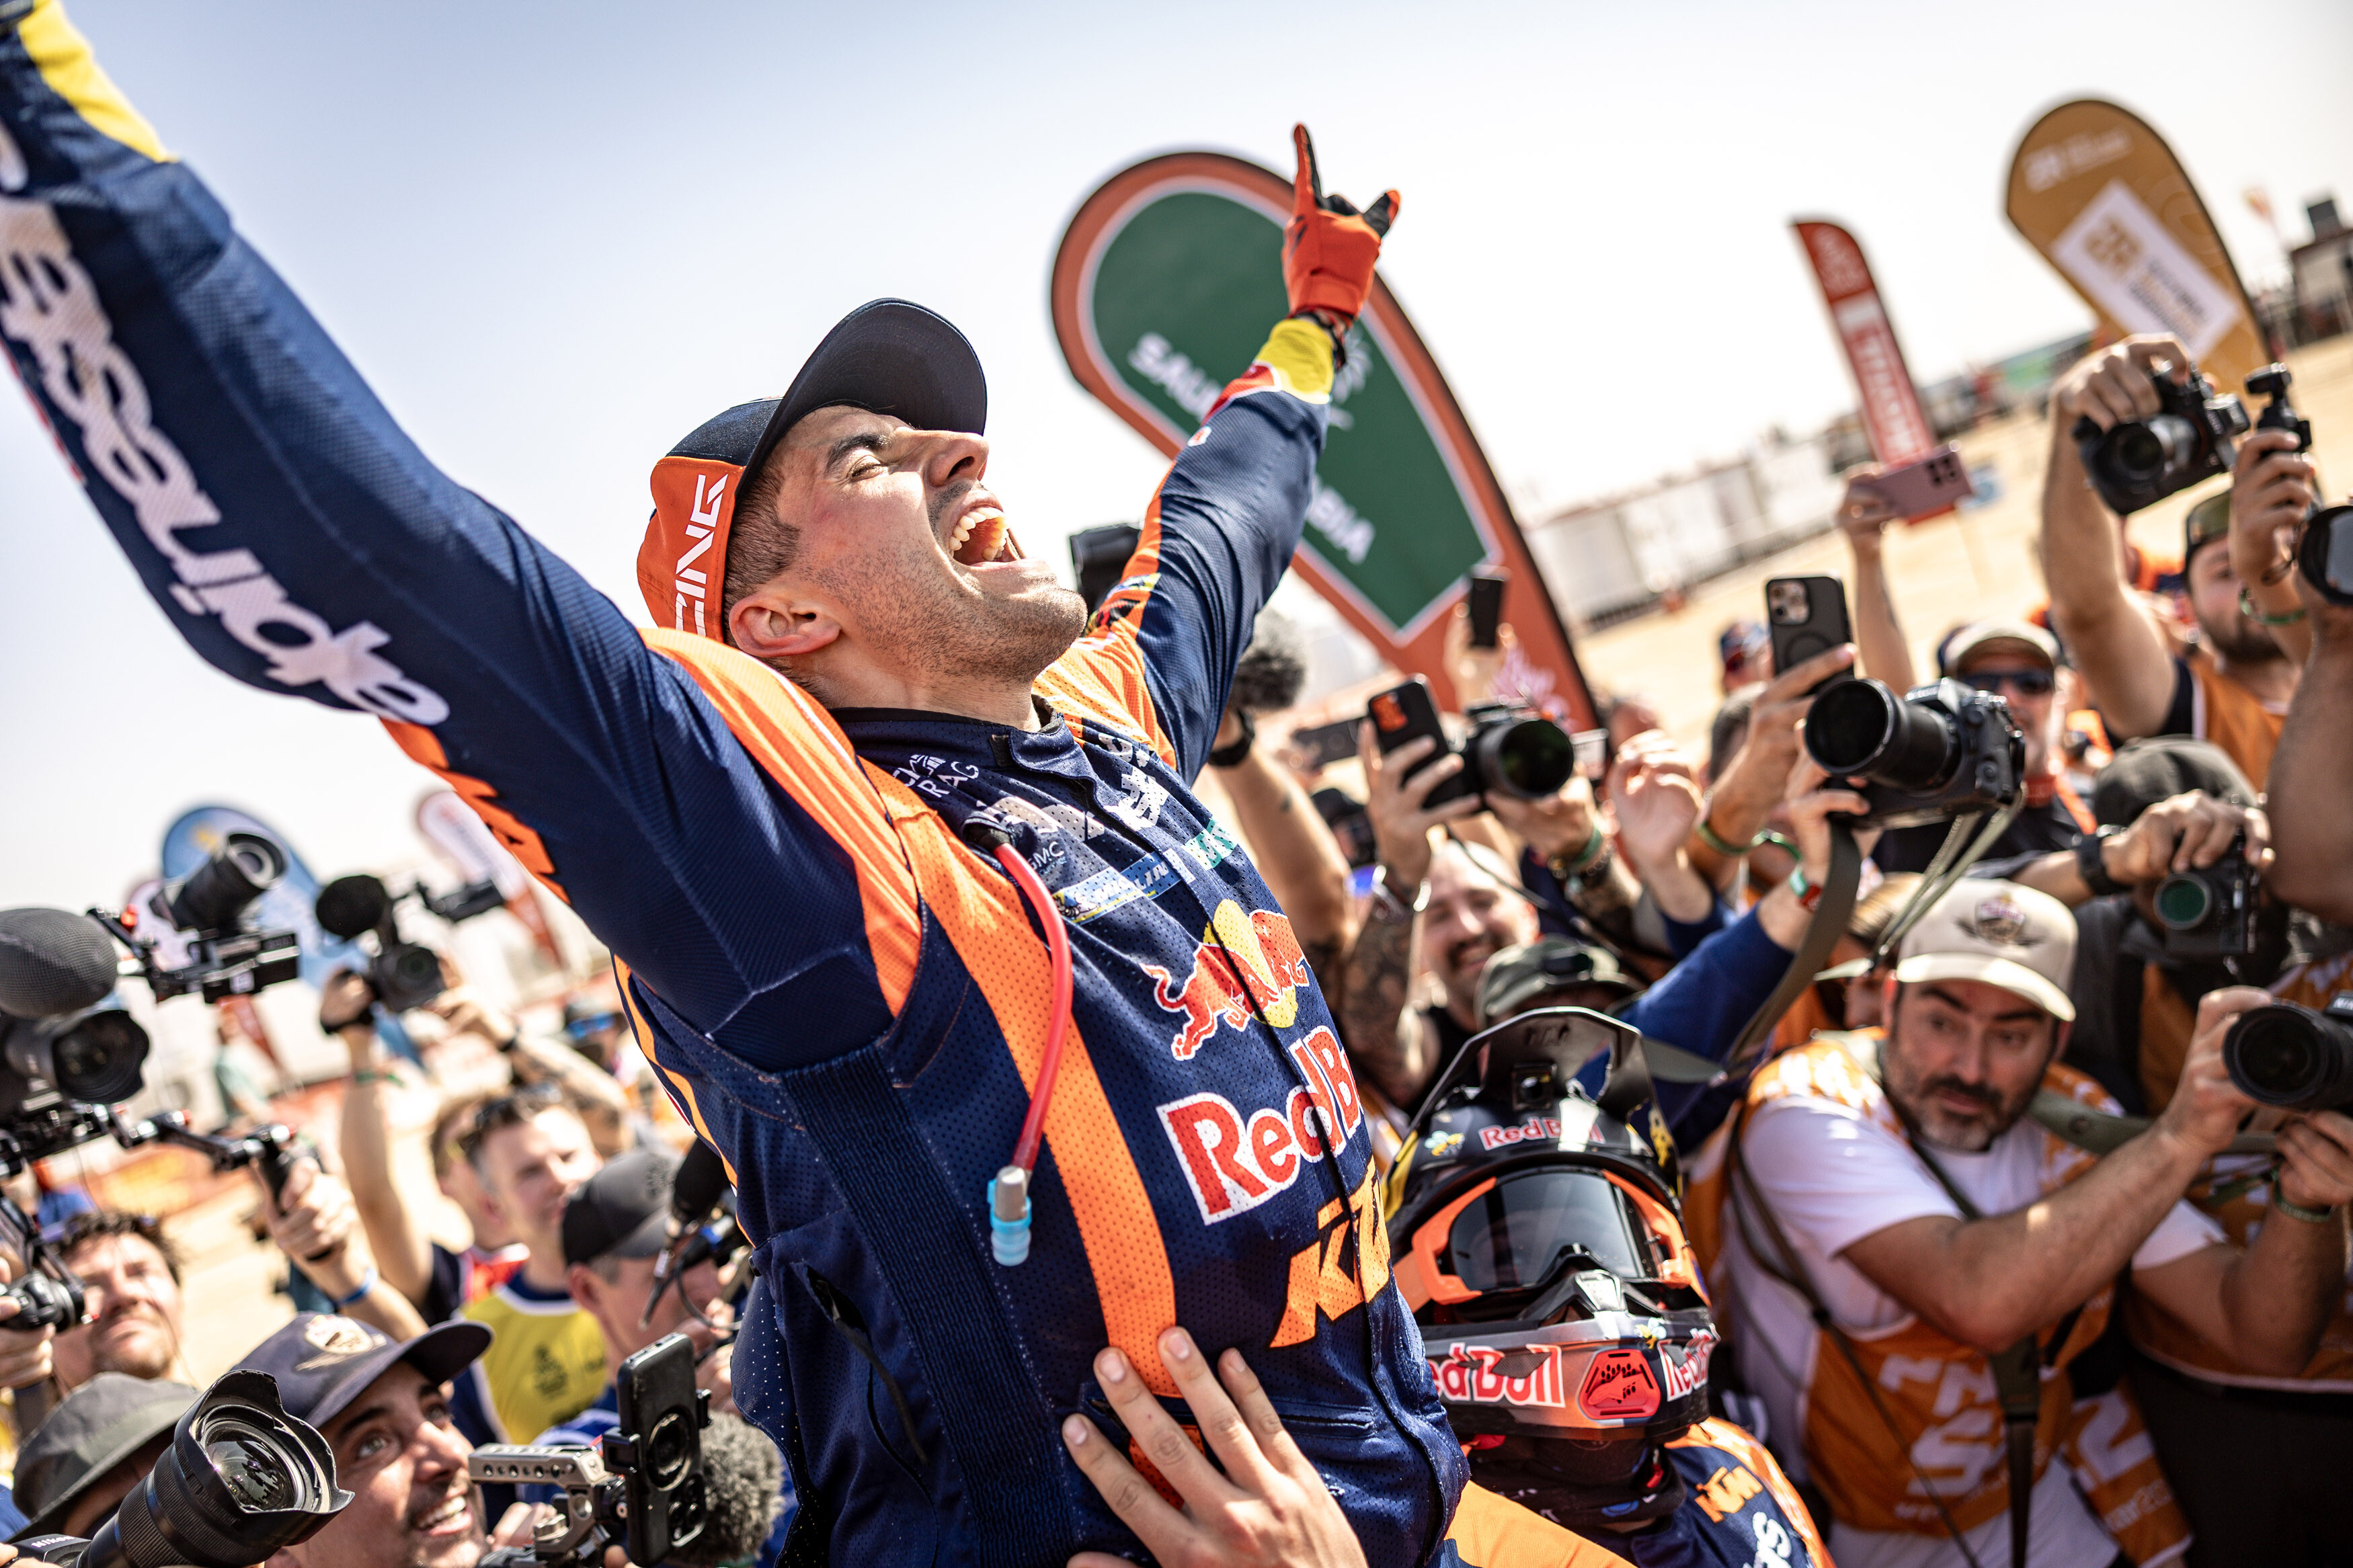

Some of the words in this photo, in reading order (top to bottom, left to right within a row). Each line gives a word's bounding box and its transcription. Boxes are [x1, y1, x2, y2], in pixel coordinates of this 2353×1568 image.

[1127, 331, 1222, 423] SAU
[1307, 474, 1377, 566] BIA
[675, 473, 729, 636] CING
[1092, 860, 1170, 903] MICLIN
[1156, 1038, 1347, 1226] Red
[1478, 1116, 1547, 1151] Red
[1541, 1117, 1607, 1145] Bll
[1427, 1342, 1472, 1401] ed
[1694, 1465, 1763, 1523] KTM
[31, 1536, 75, 1548] Nikon
